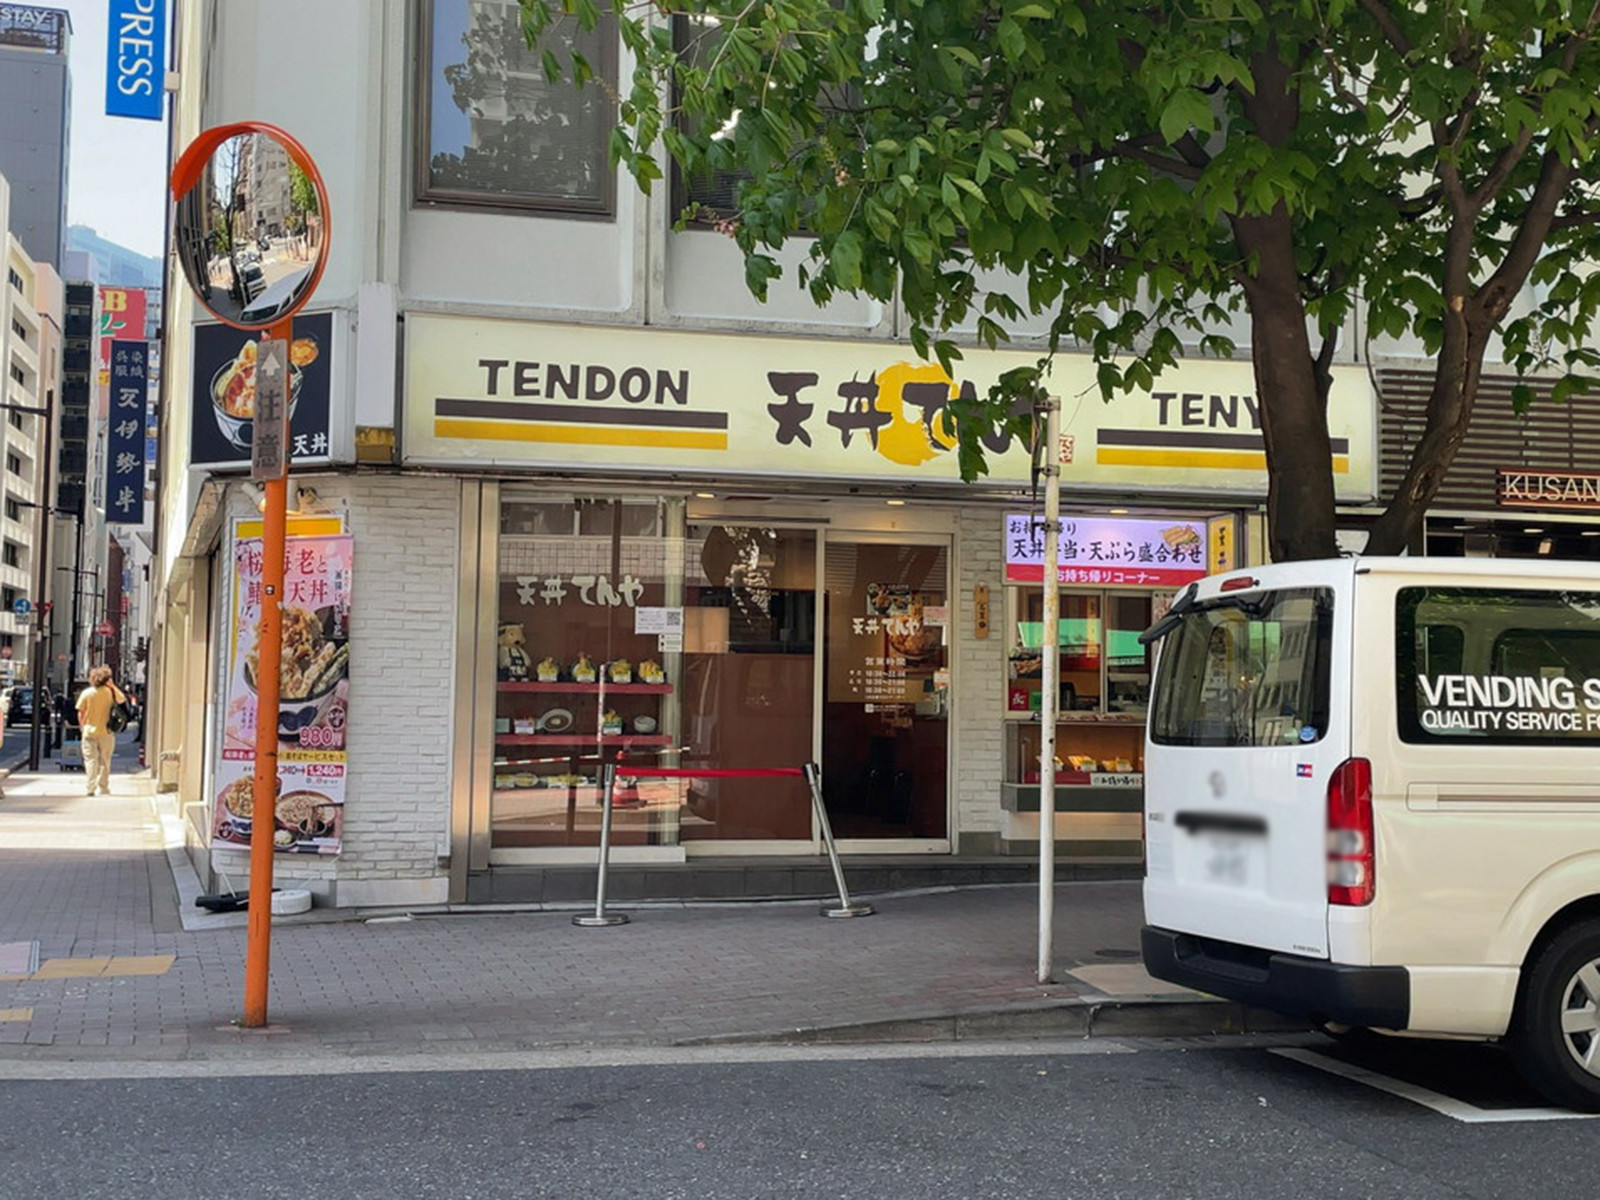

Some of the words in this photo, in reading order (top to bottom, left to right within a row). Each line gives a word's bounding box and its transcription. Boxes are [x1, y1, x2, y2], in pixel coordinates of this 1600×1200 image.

[478, 359, 689, 405] TENDON
[767, 371, 1047, 456] 天丼て
[1151, 392, 1261, 429] TENY
[293, 432, 328, 455] 天丼
[1012, 538, 1202, 564] 天丼当・天ぷら盛合わせ
[1418, 674, 1576, 710] VENDING
[1422, 709, 1502, 729] QUALITY
[1506, 711, 1582, 731] SERVICE
